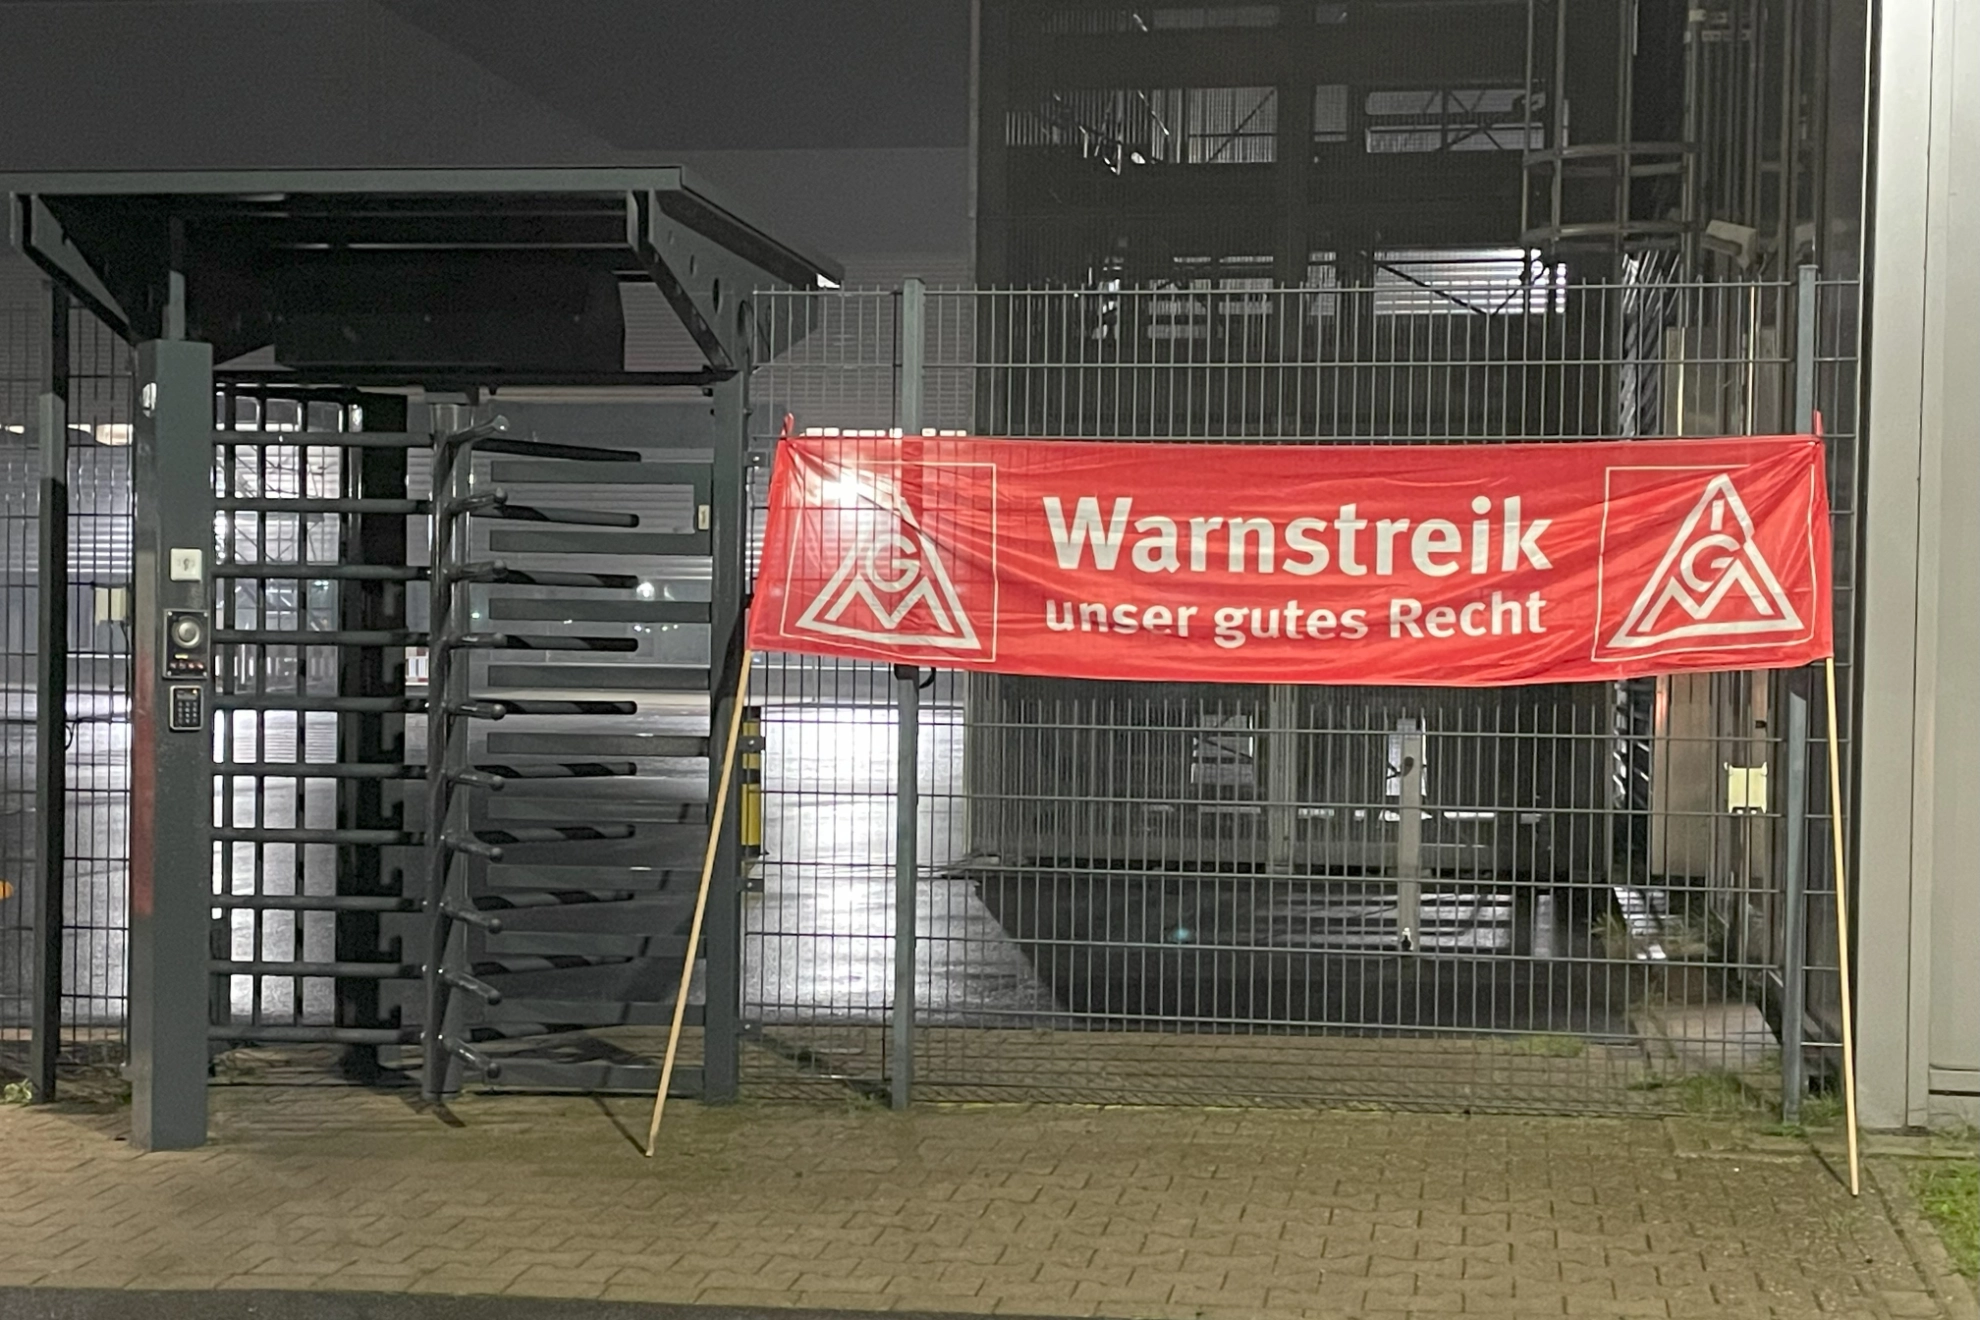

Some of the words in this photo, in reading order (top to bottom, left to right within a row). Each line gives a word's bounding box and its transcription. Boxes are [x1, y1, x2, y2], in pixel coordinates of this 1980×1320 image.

[1042, 495, 1555, 577] Warnstreik
[1046, 599, 1198, 638] unser
[1213, 599, 1369, 649] gutes
[1389, 590, 1547, 639] Recht
